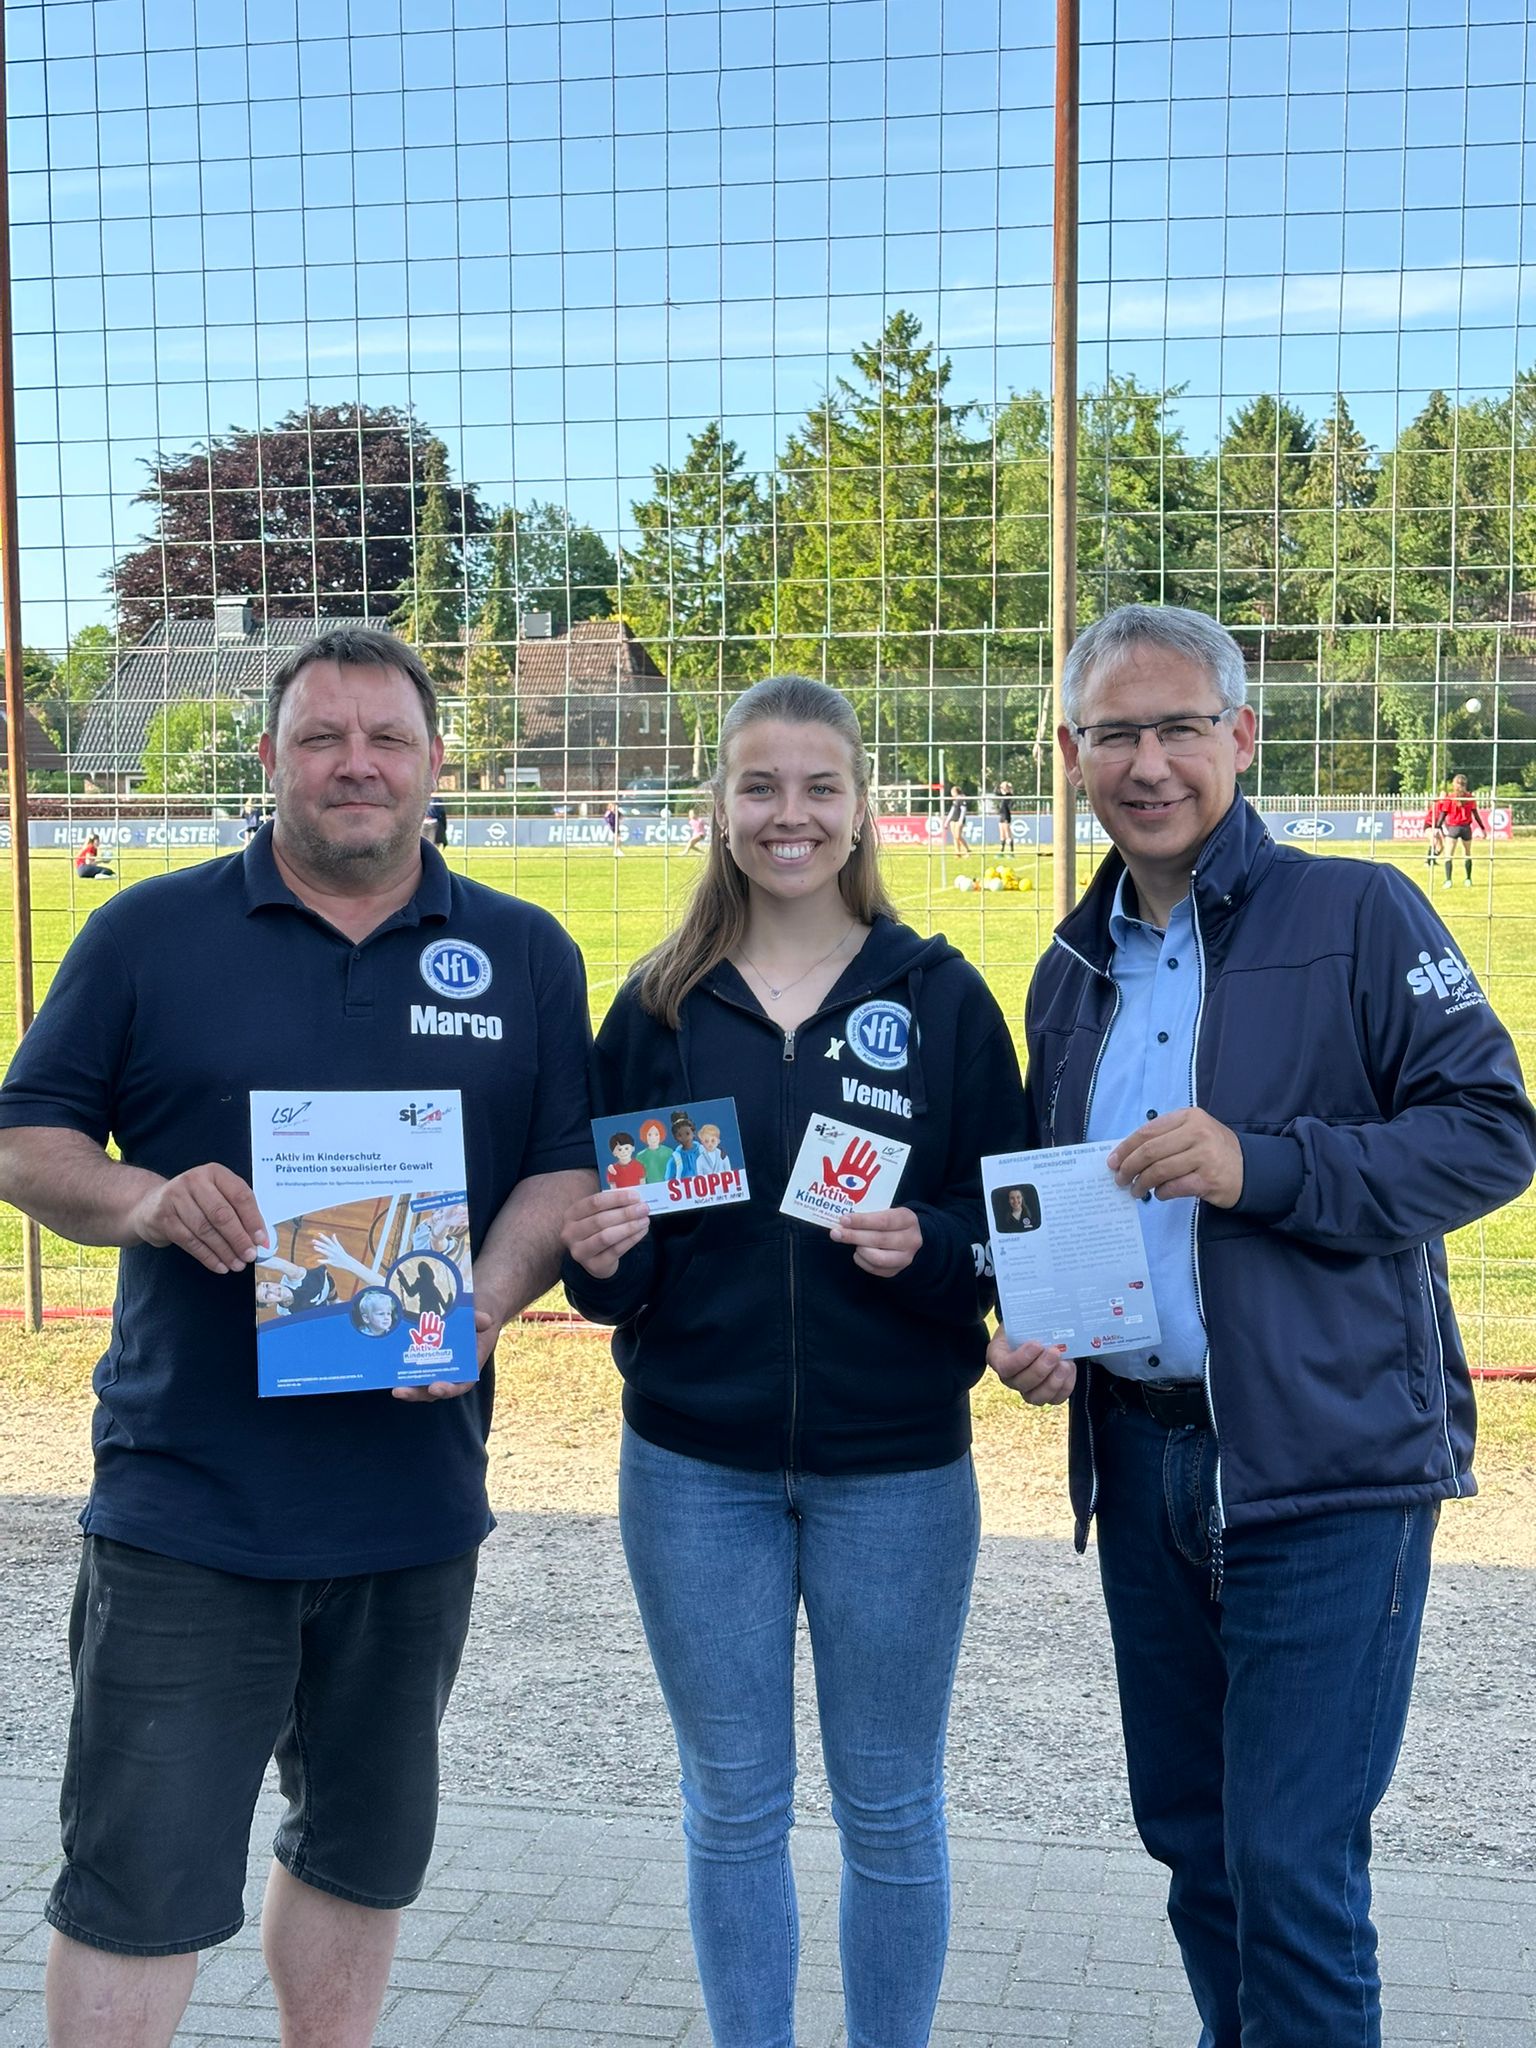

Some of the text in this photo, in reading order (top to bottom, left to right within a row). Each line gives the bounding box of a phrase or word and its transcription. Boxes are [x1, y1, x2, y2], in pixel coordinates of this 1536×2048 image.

[54, 826, 131, 844] HELLWIG
[146, 823, 220, 843] FÖLSTER
[549, 825, 630, 843] HELLWIG
[1292, 821, 1331, 836] Ford
[1356, 816, 1383, 837] HF
[434, 951, 476, 983] VfL
[410, 1004, 503, 1040] Marco
[861, 1014, 902, 1053] VfL
[841, 1076, 913, 1119] Vemke
[275, 1153, 300, 1162] Aktiv
[302, 1153, 315, 1161] im
[318, 1152, 382, 1161] Kinderschutz
[275, 1162, 434, 1173] Prävention sexualisierter Gewalt
[667, 1168, 743, 1202] STOPP!
[808, 1181, 847, 1203] Aktiv
